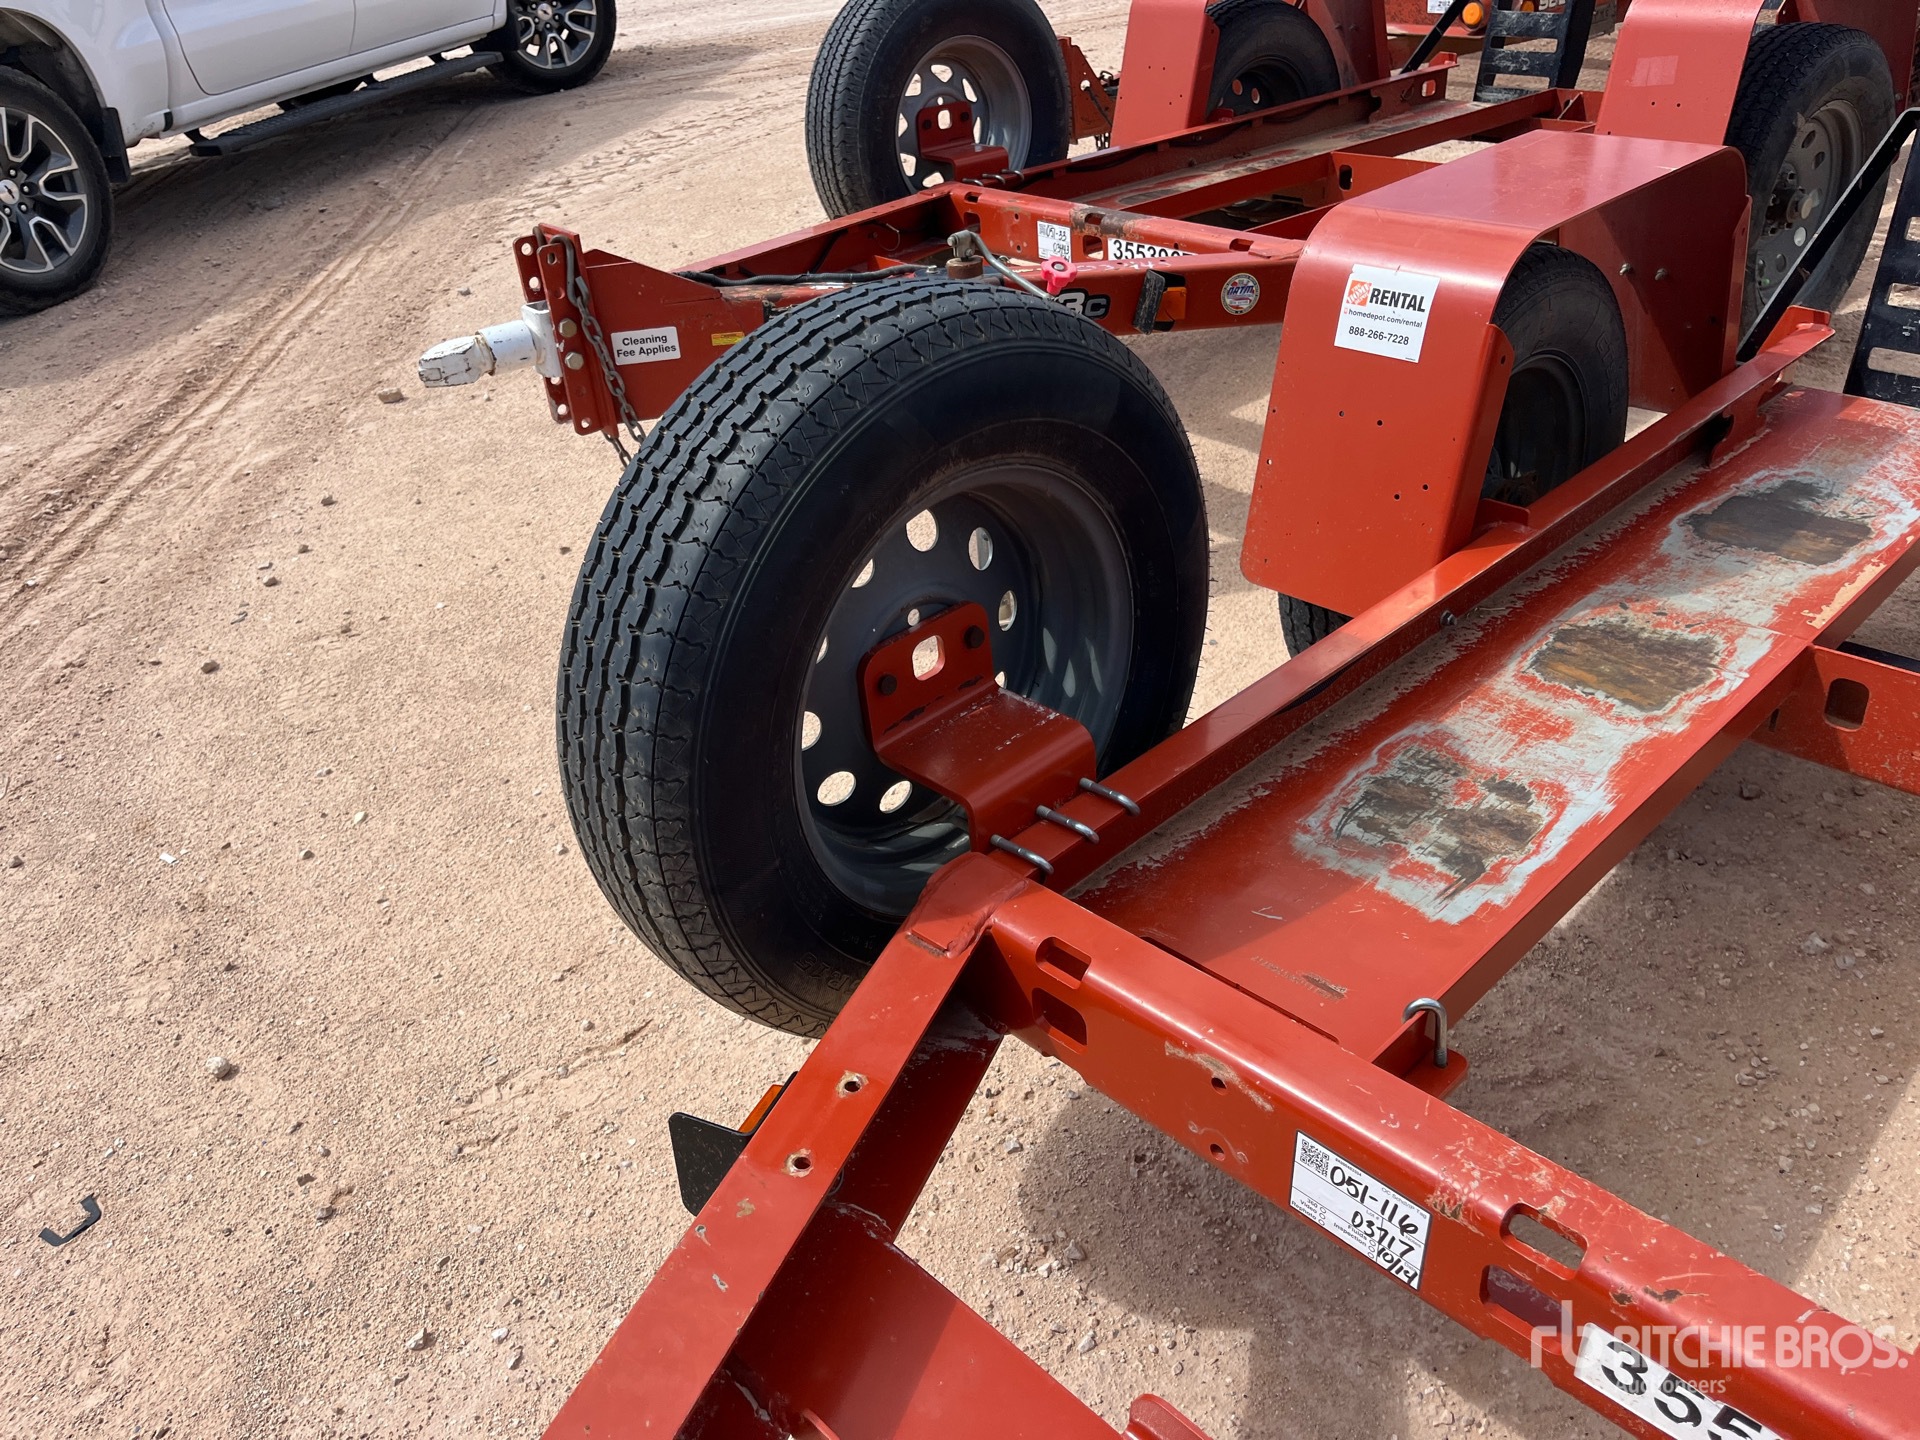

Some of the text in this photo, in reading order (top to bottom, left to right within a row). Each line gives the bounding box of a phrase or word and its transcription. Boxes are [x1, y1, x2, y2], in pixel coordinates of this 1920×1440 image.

[1369, 287, 1426, 313] RENTAL
[1348, 308, 1423, 328] homedepot.com/rental
[622, 334, 668, 347] Cleaning
[1348, 325, 1410, 346] 888-266-7228
[616, 344, 677, 358] Fee Applies
[1299, 1199, 1318, 1214] Video
[1329, 1165, 1419, 1237] 051-116
[1366, 1209, 1375, 1218] Lot
[1333, 1222, 1367, 1247] Inspection
[1347, 1224, 1368, 1241] Fluids
[1351, 1210, 1416, 1259] 03717
